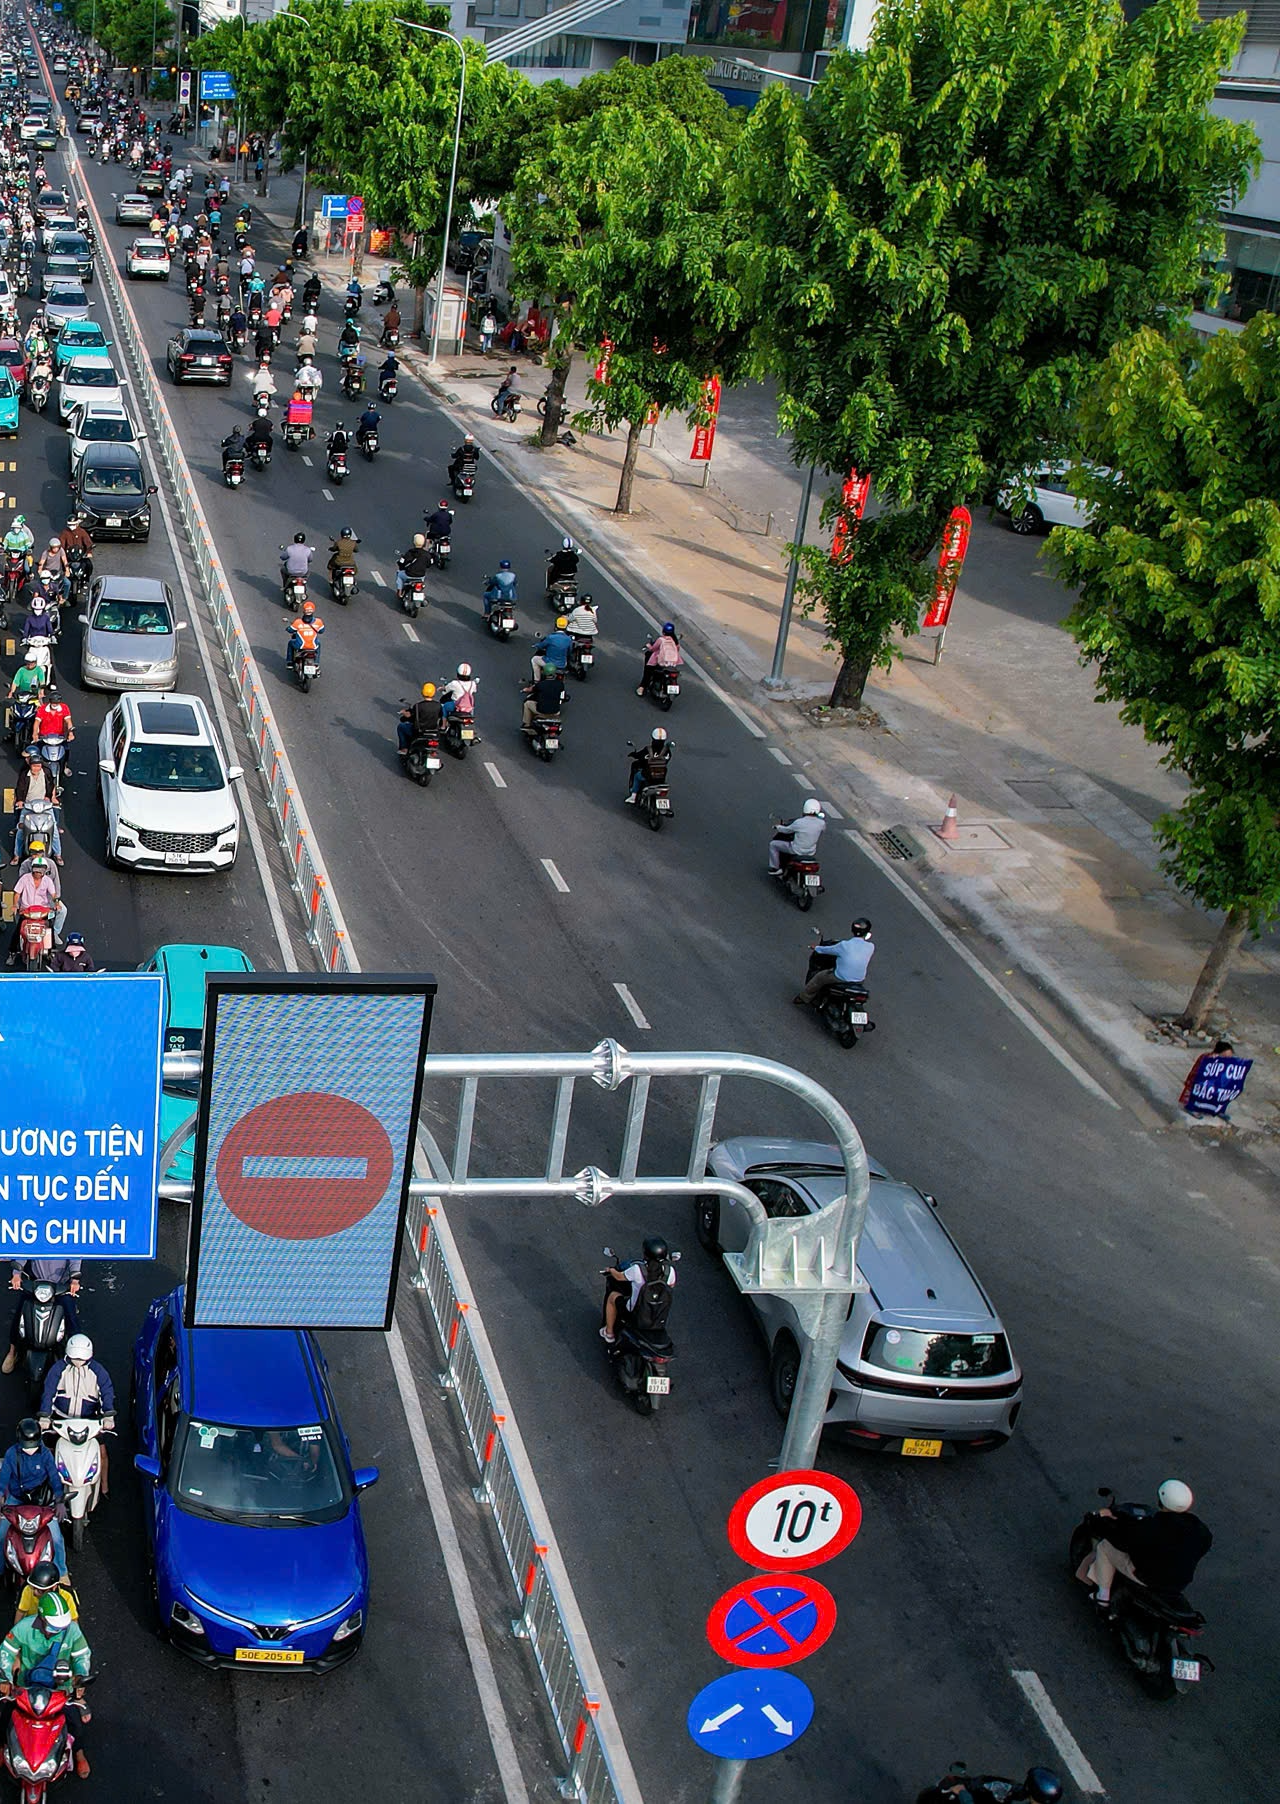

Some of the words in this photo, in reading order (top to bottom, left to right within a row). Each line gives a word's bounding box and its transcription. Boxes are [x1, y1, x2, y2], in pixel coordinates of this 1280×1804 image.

[1203, 1059, 1225, 1077] SÚP
[84, 1124, 144, 1162] TIỆN
[17, 1174, 69, 1207] TỤC
[74, 1164, 129, 1201] ĐẾN
[45, 1219, 127, 1245] CHINH
[241, 1650, 299, 1662] 50E-205.61
